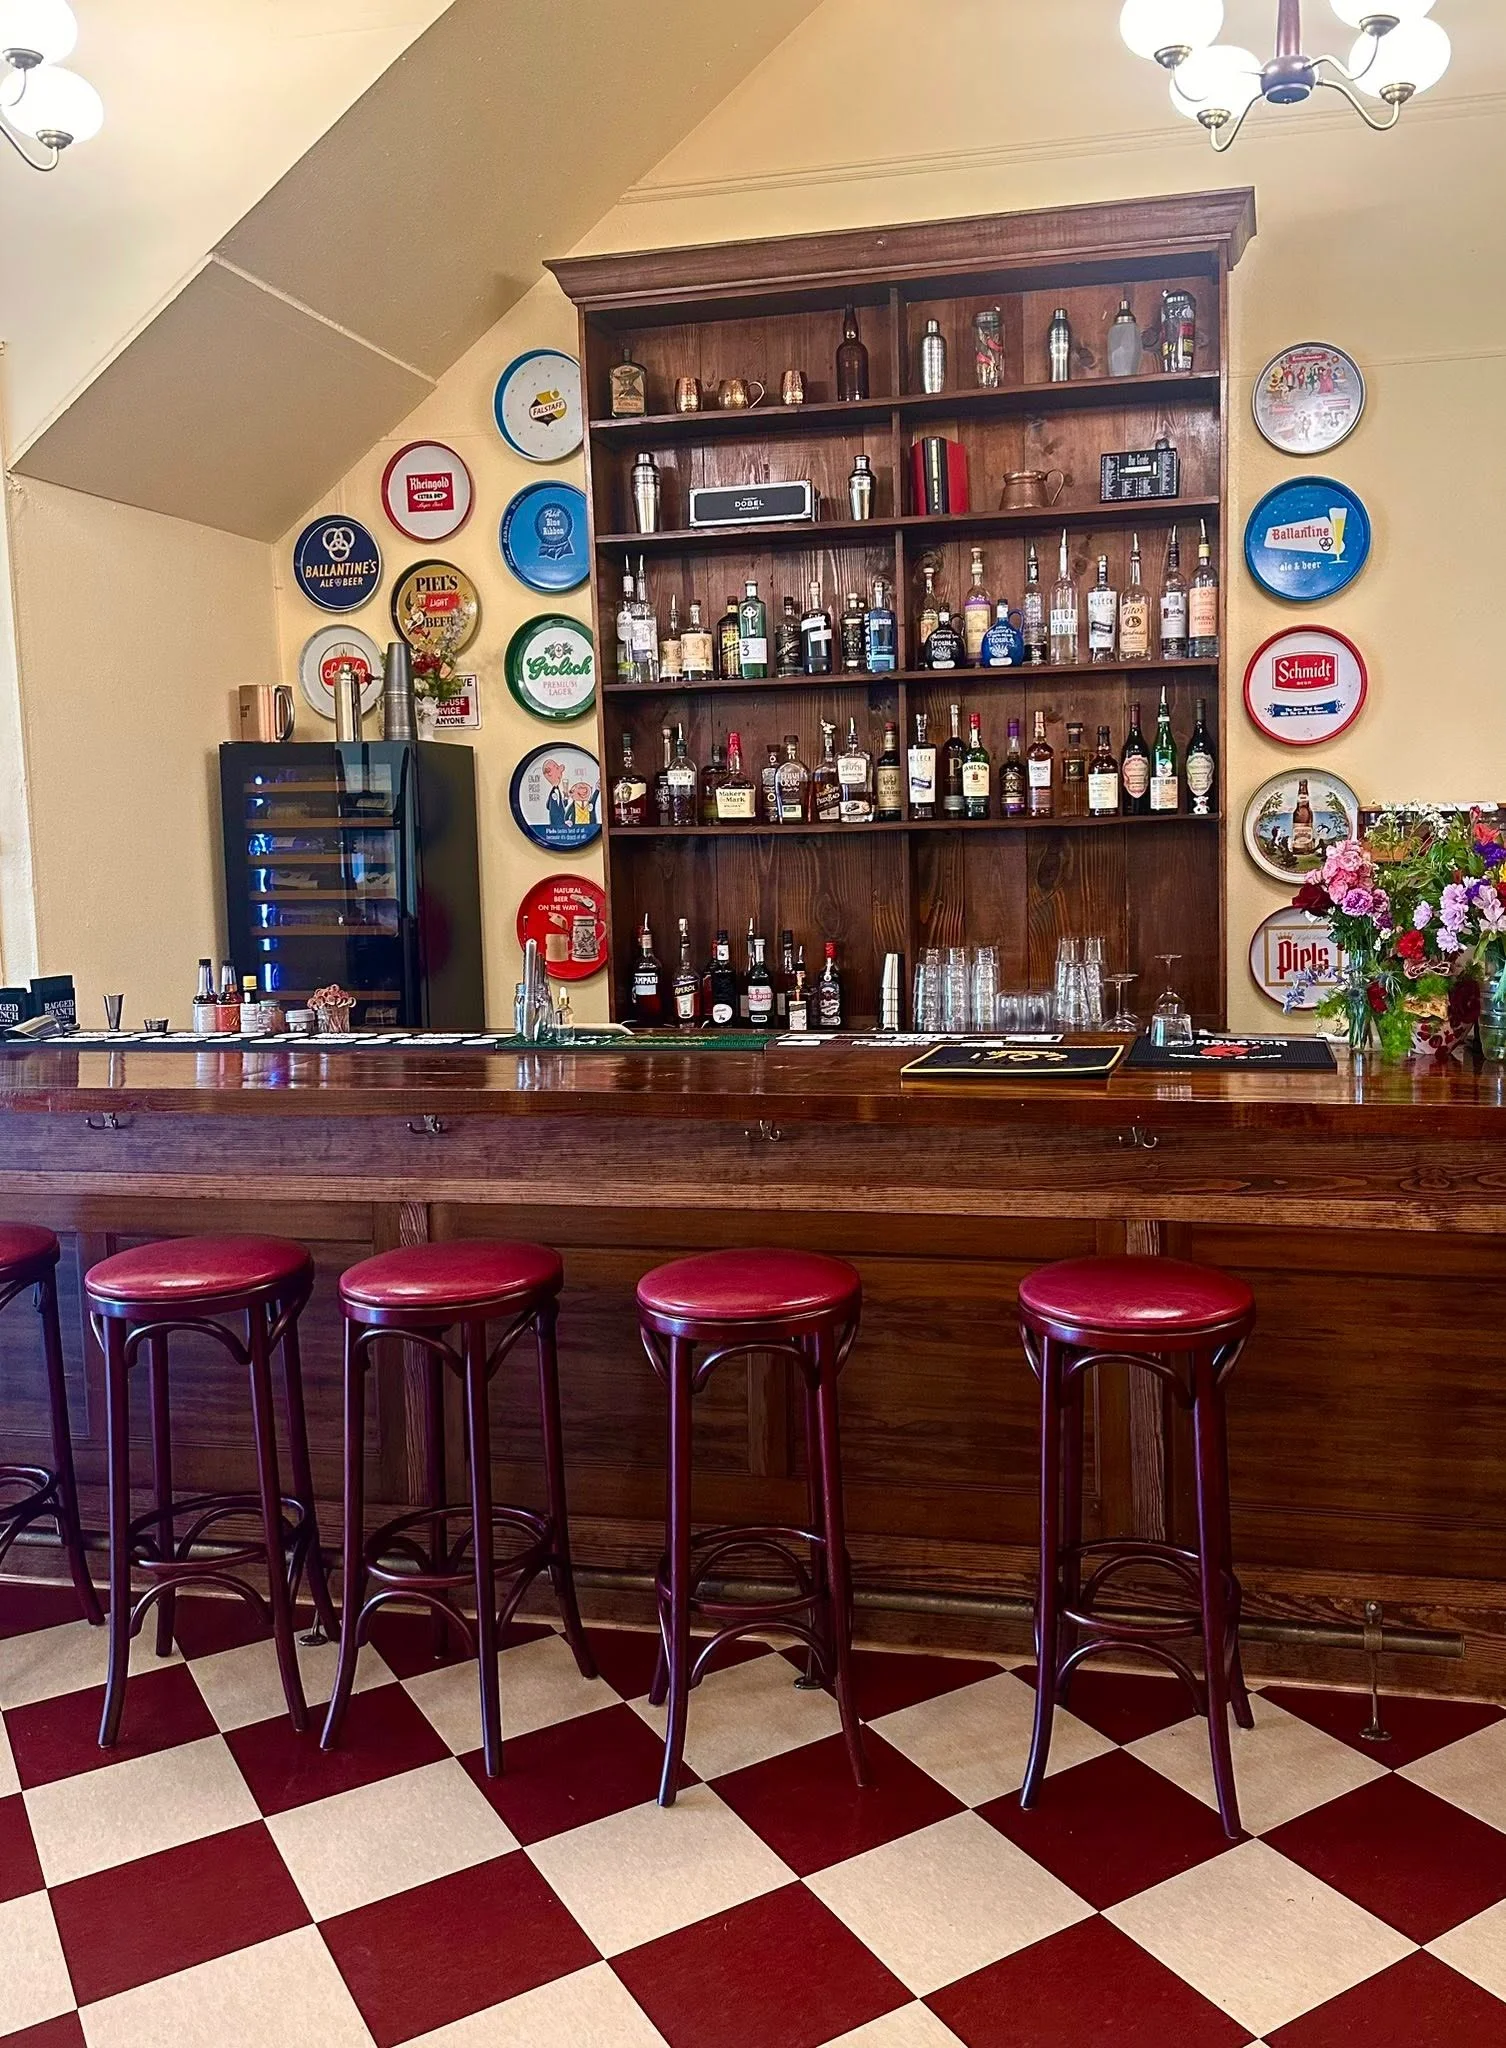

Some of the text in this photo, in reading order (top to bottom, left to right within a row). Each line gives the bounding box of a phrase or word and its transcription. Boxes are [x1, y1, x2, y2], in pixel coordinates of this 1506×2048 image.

[533, 401, 563, 416] FALSTAFF
[410, 476, 450, 490] Rheingold
[545, 518, 560, 527] Blue
[543, 527, 565, 536] Ribbon
[1272, 525, 1329, 540] Ballantine
[305, 559, 377, 578] BALLANTINE'S
[1280, 562, 1292, 570] ale
[1302, 561, 1321, 570] beer
[319, 577, 363, 588] ALE BEER
[416, 575, 458, 592] PIEL'S
[430, 598, 449, 607] LIGHT
[1122, 604, 1144, 615] Tito's
[742, 645, 750, 656] 3
[526, 656, 593, 680] Grolsch
[1278, 659, 1332, 682] Schmidt
[543, 681, 577, 689] PREMIUM
[949, 758, 962, 776] P
[964, 764, 987, 772] JAMESON
[1277, 940, 1329, 980] Piels
[635, 976, 658, 985] AMPARI
[674, 984, 695, 995] APEROL
[44, 999, 74, 1011] RAGGED
[0, 1011, 19, 1020] NCH
